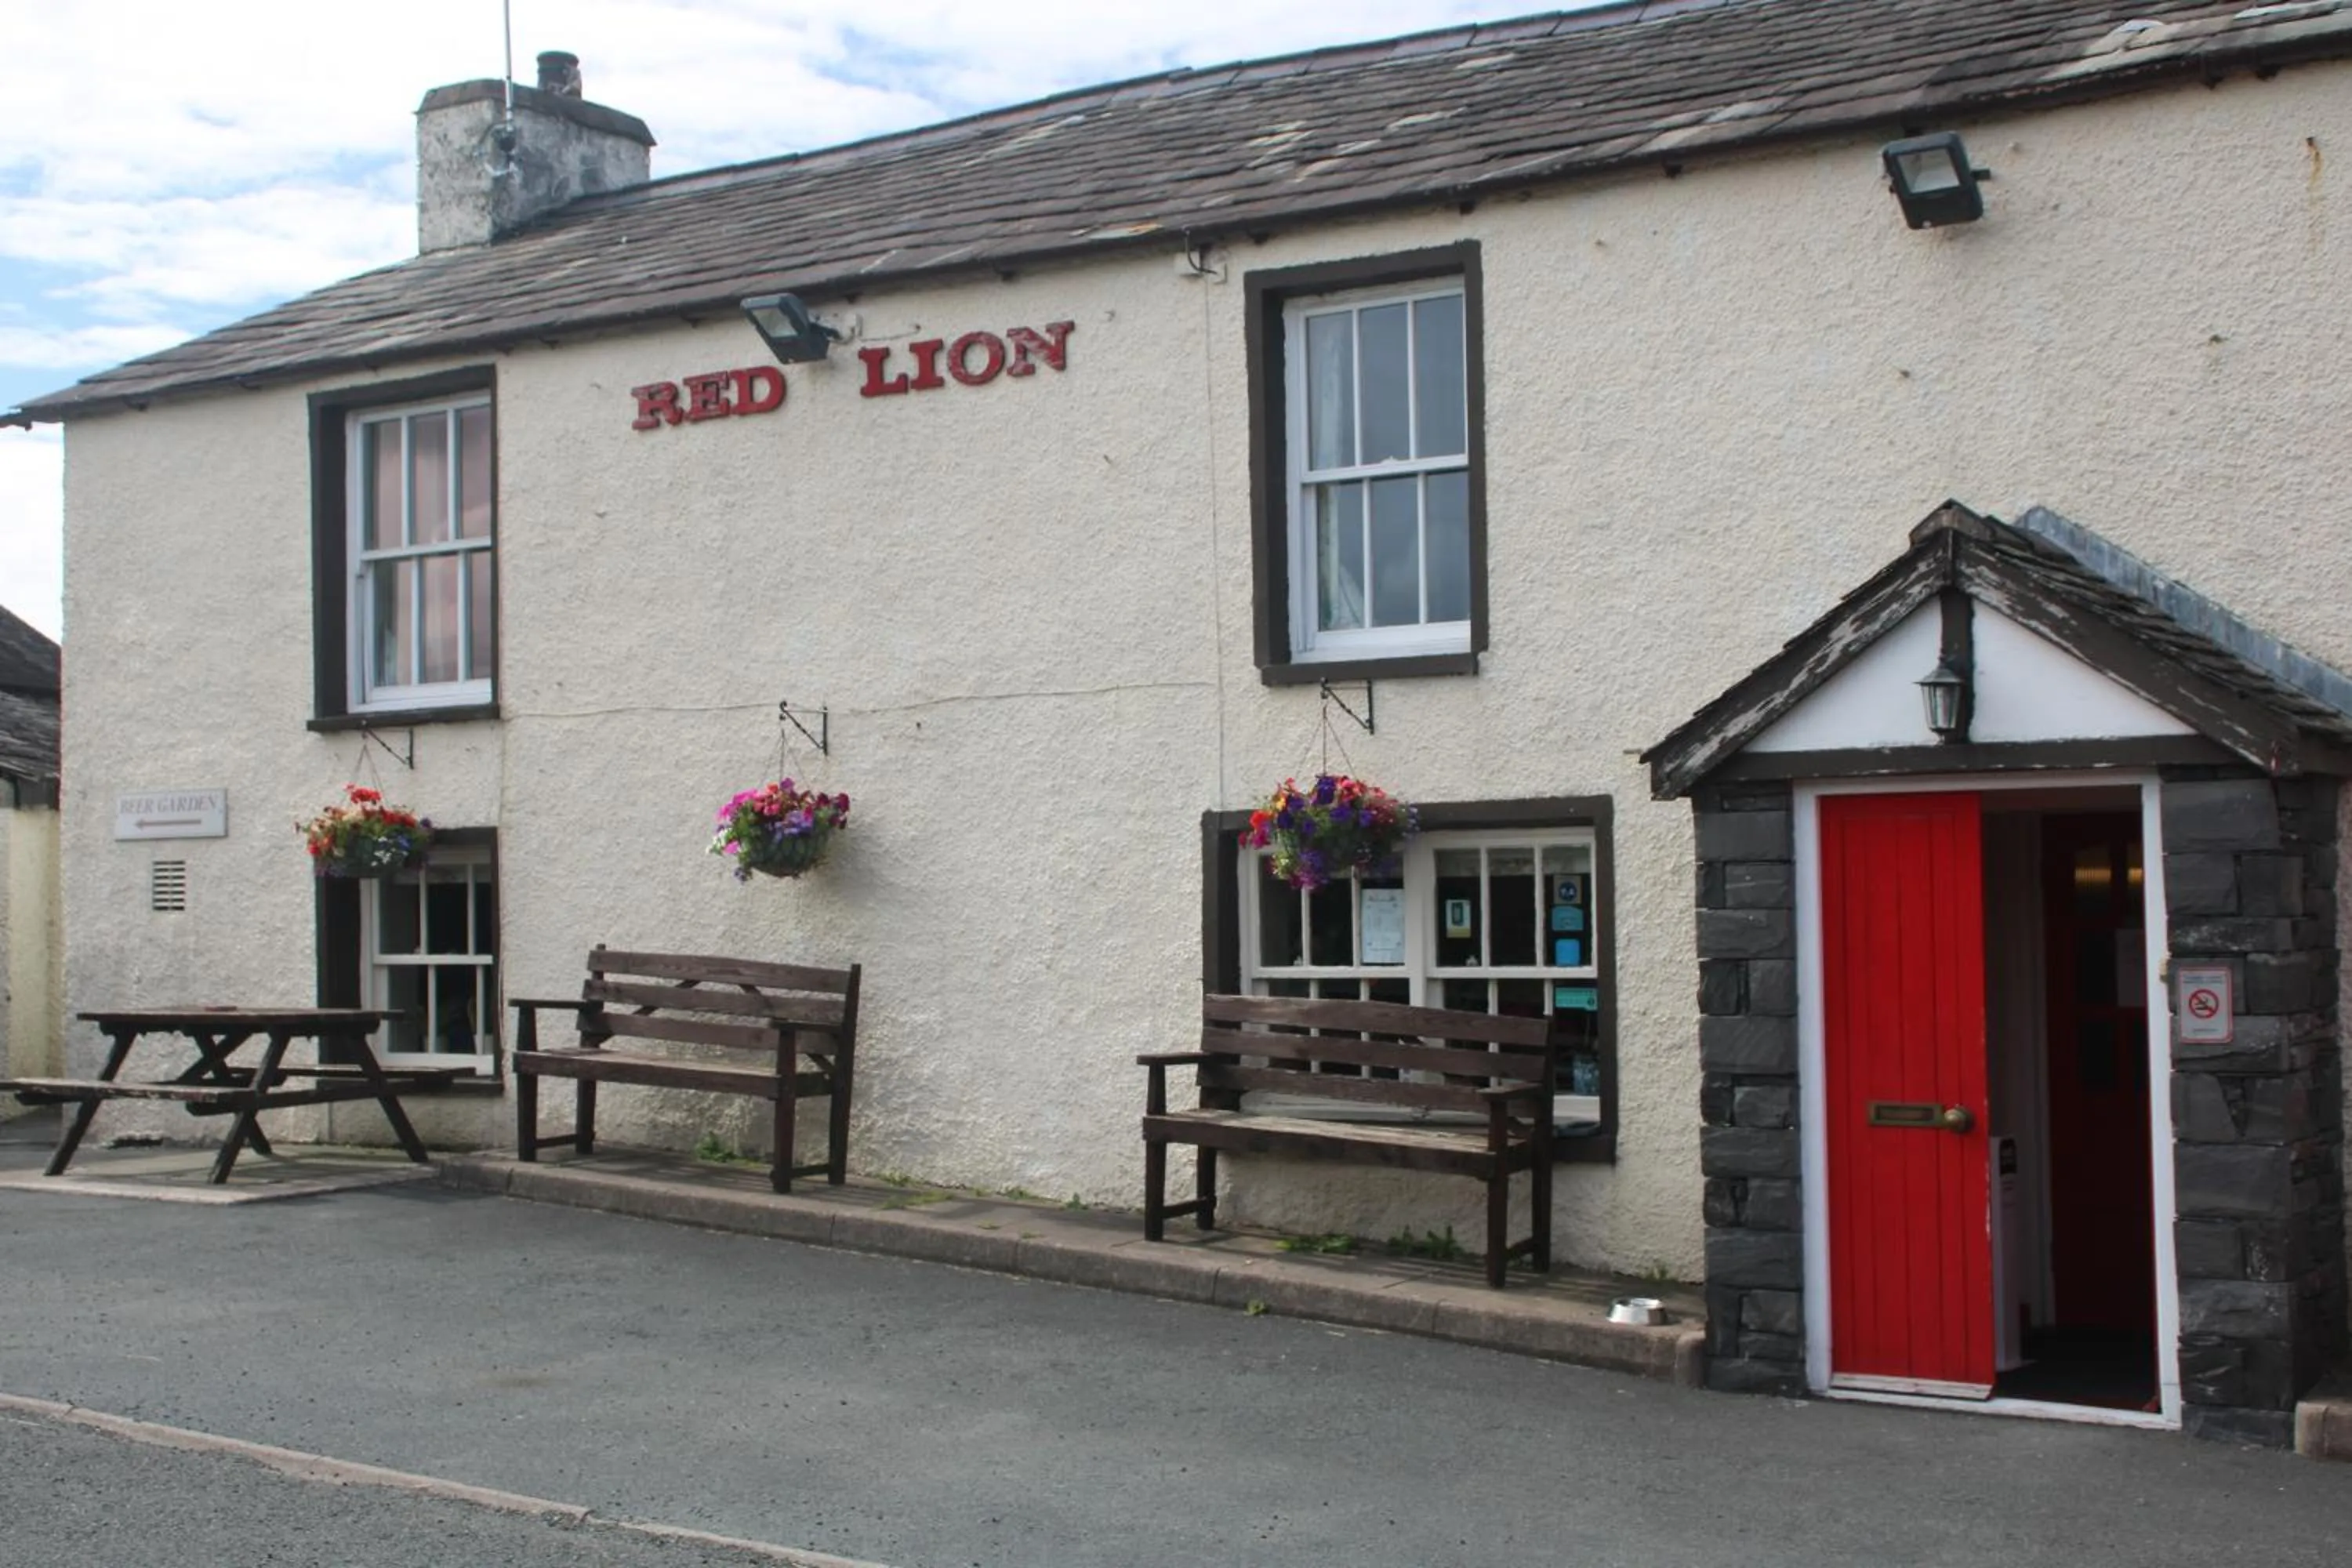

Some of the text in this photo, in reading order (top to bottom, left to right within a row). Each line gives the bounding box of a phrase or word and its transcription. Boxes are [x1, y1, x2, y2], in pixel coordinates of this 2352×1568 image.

[631, 320, 1076, 430] RED LION
[120, 795, 216, 814] BEER GARDEN
